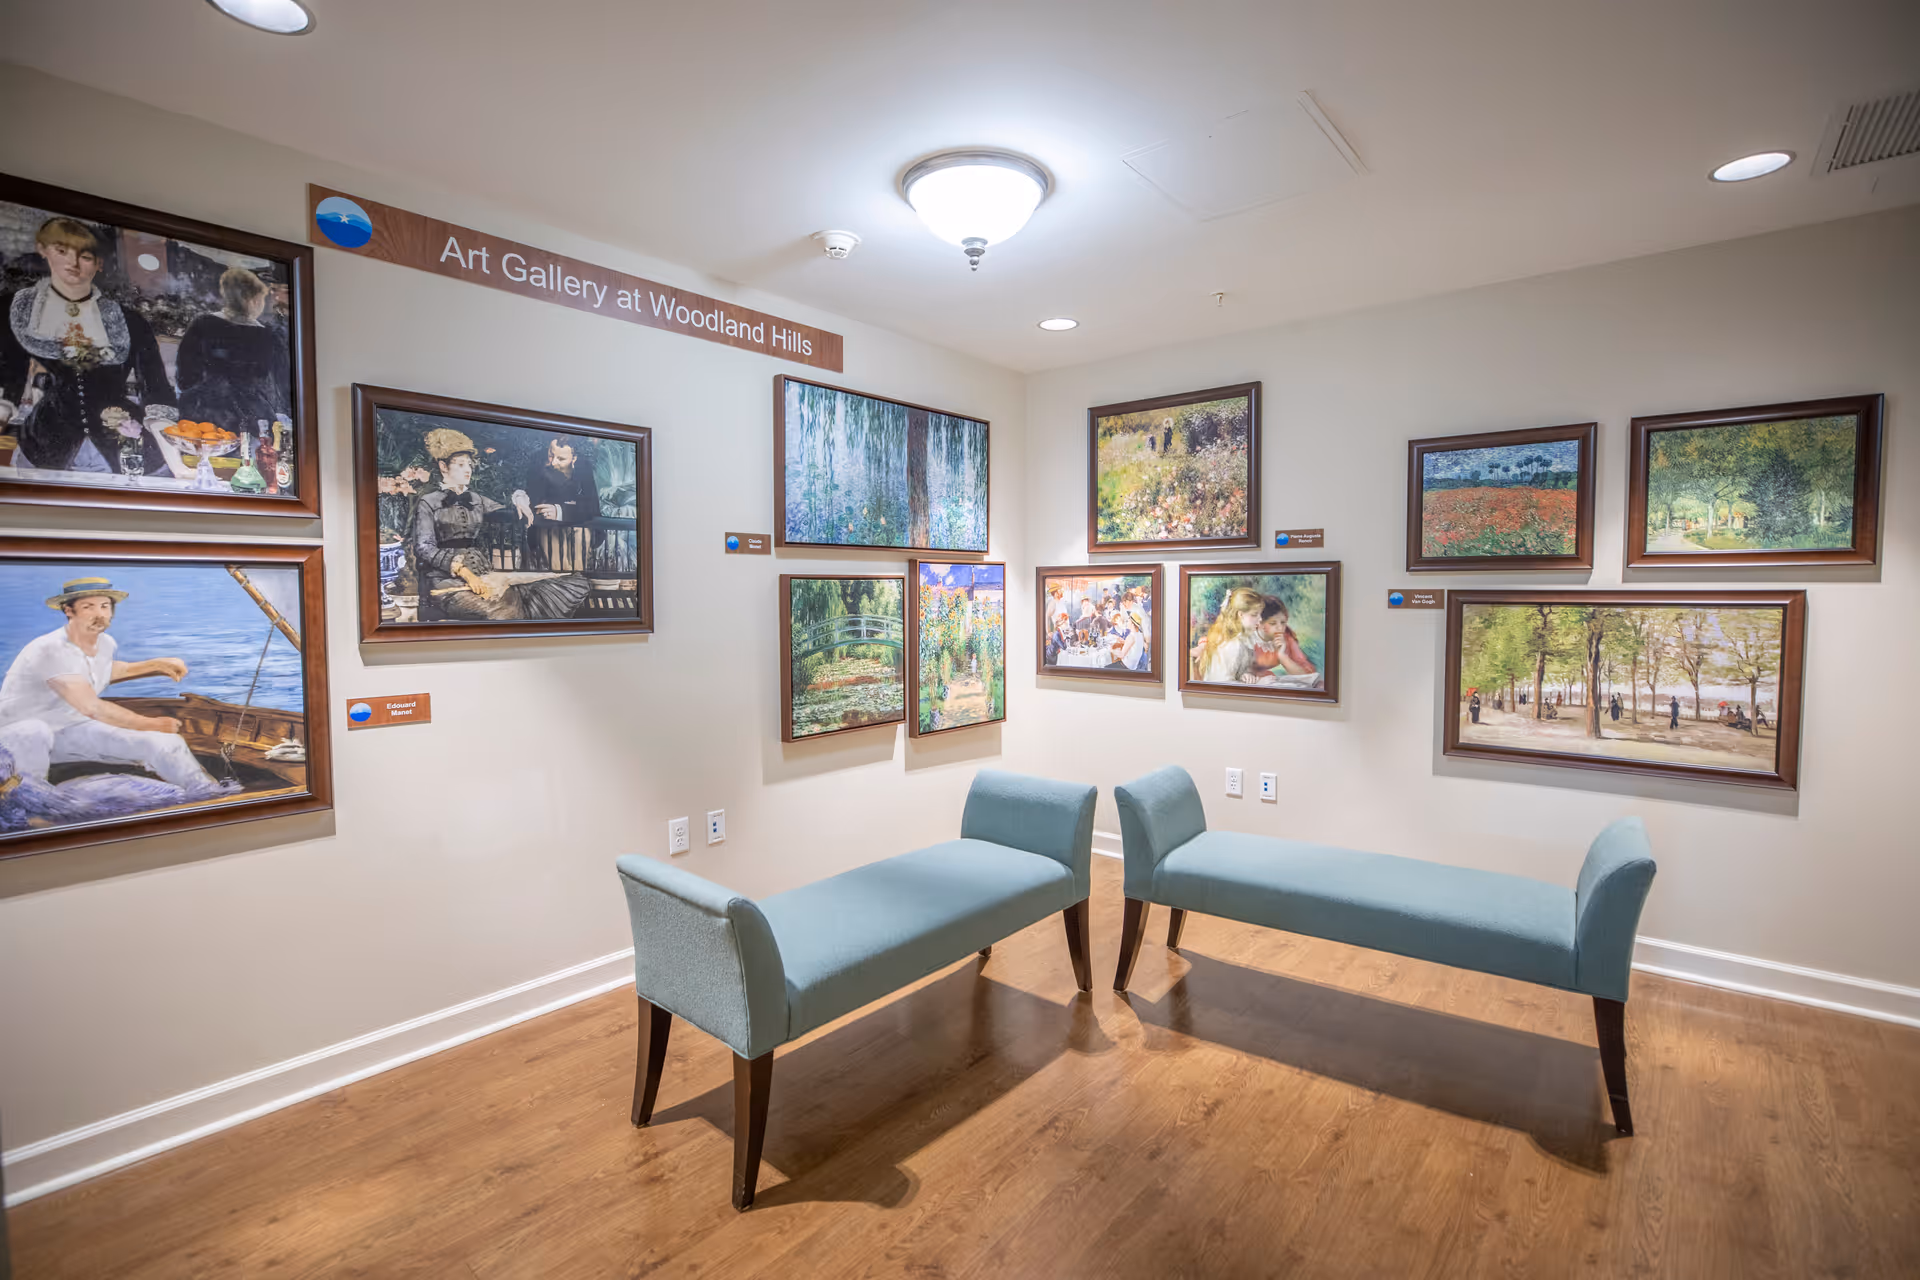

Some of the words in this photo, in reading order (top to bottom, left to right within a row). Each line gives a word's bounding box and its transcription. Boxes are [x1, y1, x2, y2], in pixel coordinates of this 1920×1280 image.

[440, 236, 491, 274] Art
[501, 253, 608, 309] Gallery
[616, 288, 642, 313] at
[649, 291, 765, 344] Woodland
[772, 325, 813, 356] Hills
[386, 701, 416, 709] Edouard
